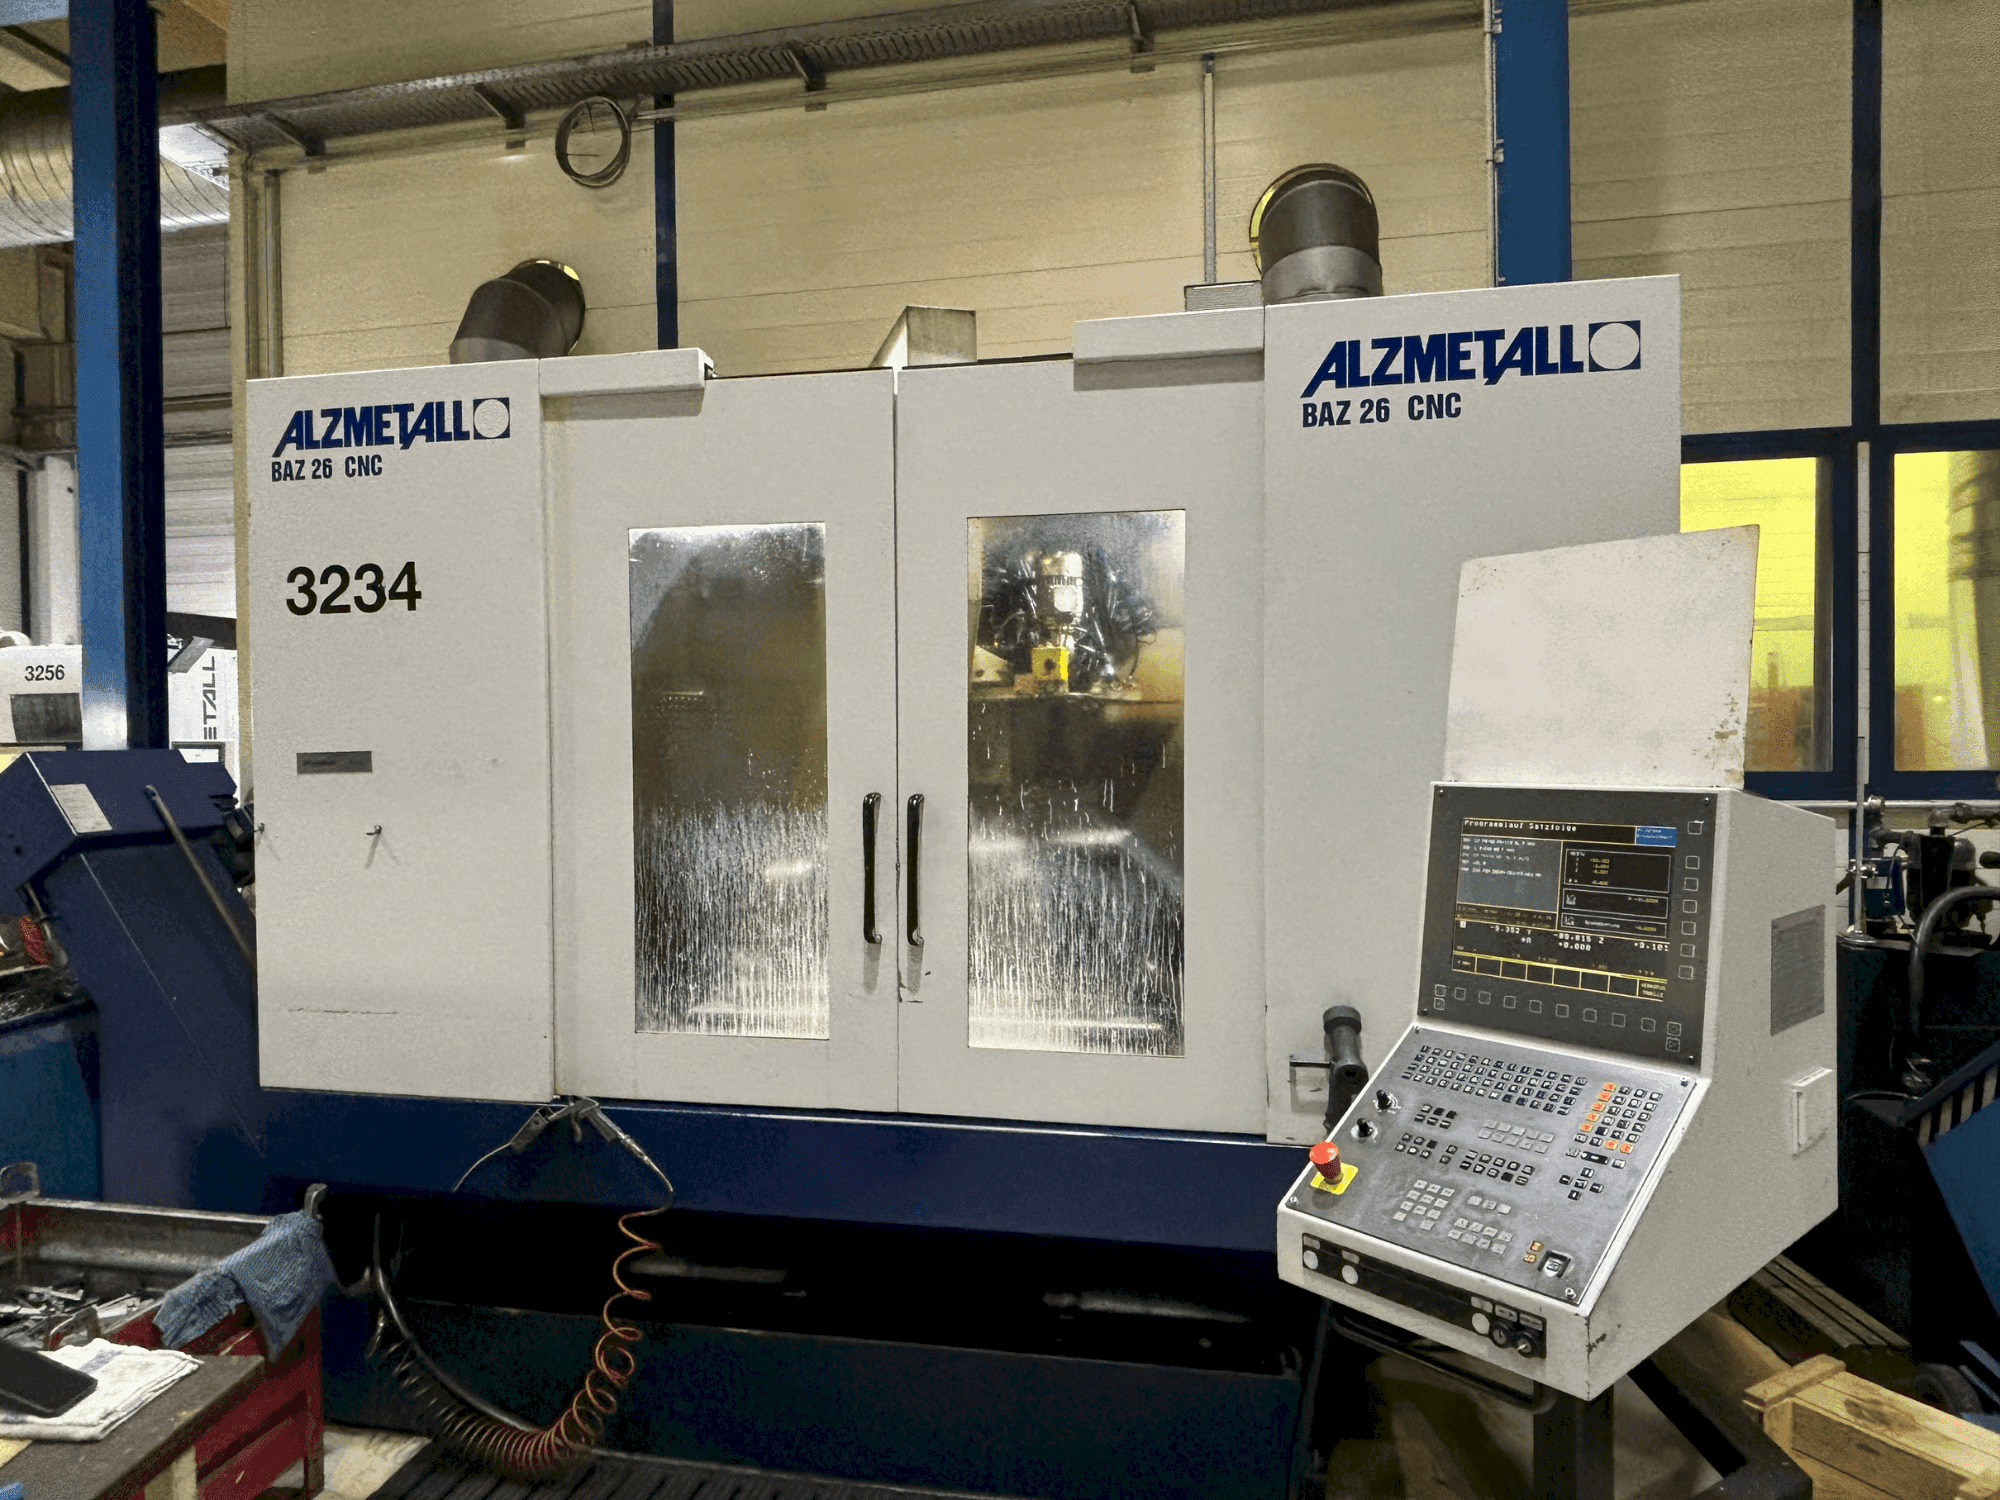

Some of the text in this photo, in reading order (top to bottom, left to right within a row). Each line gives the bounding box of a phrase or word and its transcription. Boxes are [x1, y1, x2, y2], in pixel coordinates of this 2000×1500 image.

[1300, 325, 1584, 398] ALZMETALL
[272, 400, 470, 457] ALZMETALL
[1302, 392, 1462, 428] BAZ 26 CNC
[271, 454, 383, 482] BAZ 26 CNC
[286, 561, 422, 616] 3234
[24, 664, 65, 682] 3256
